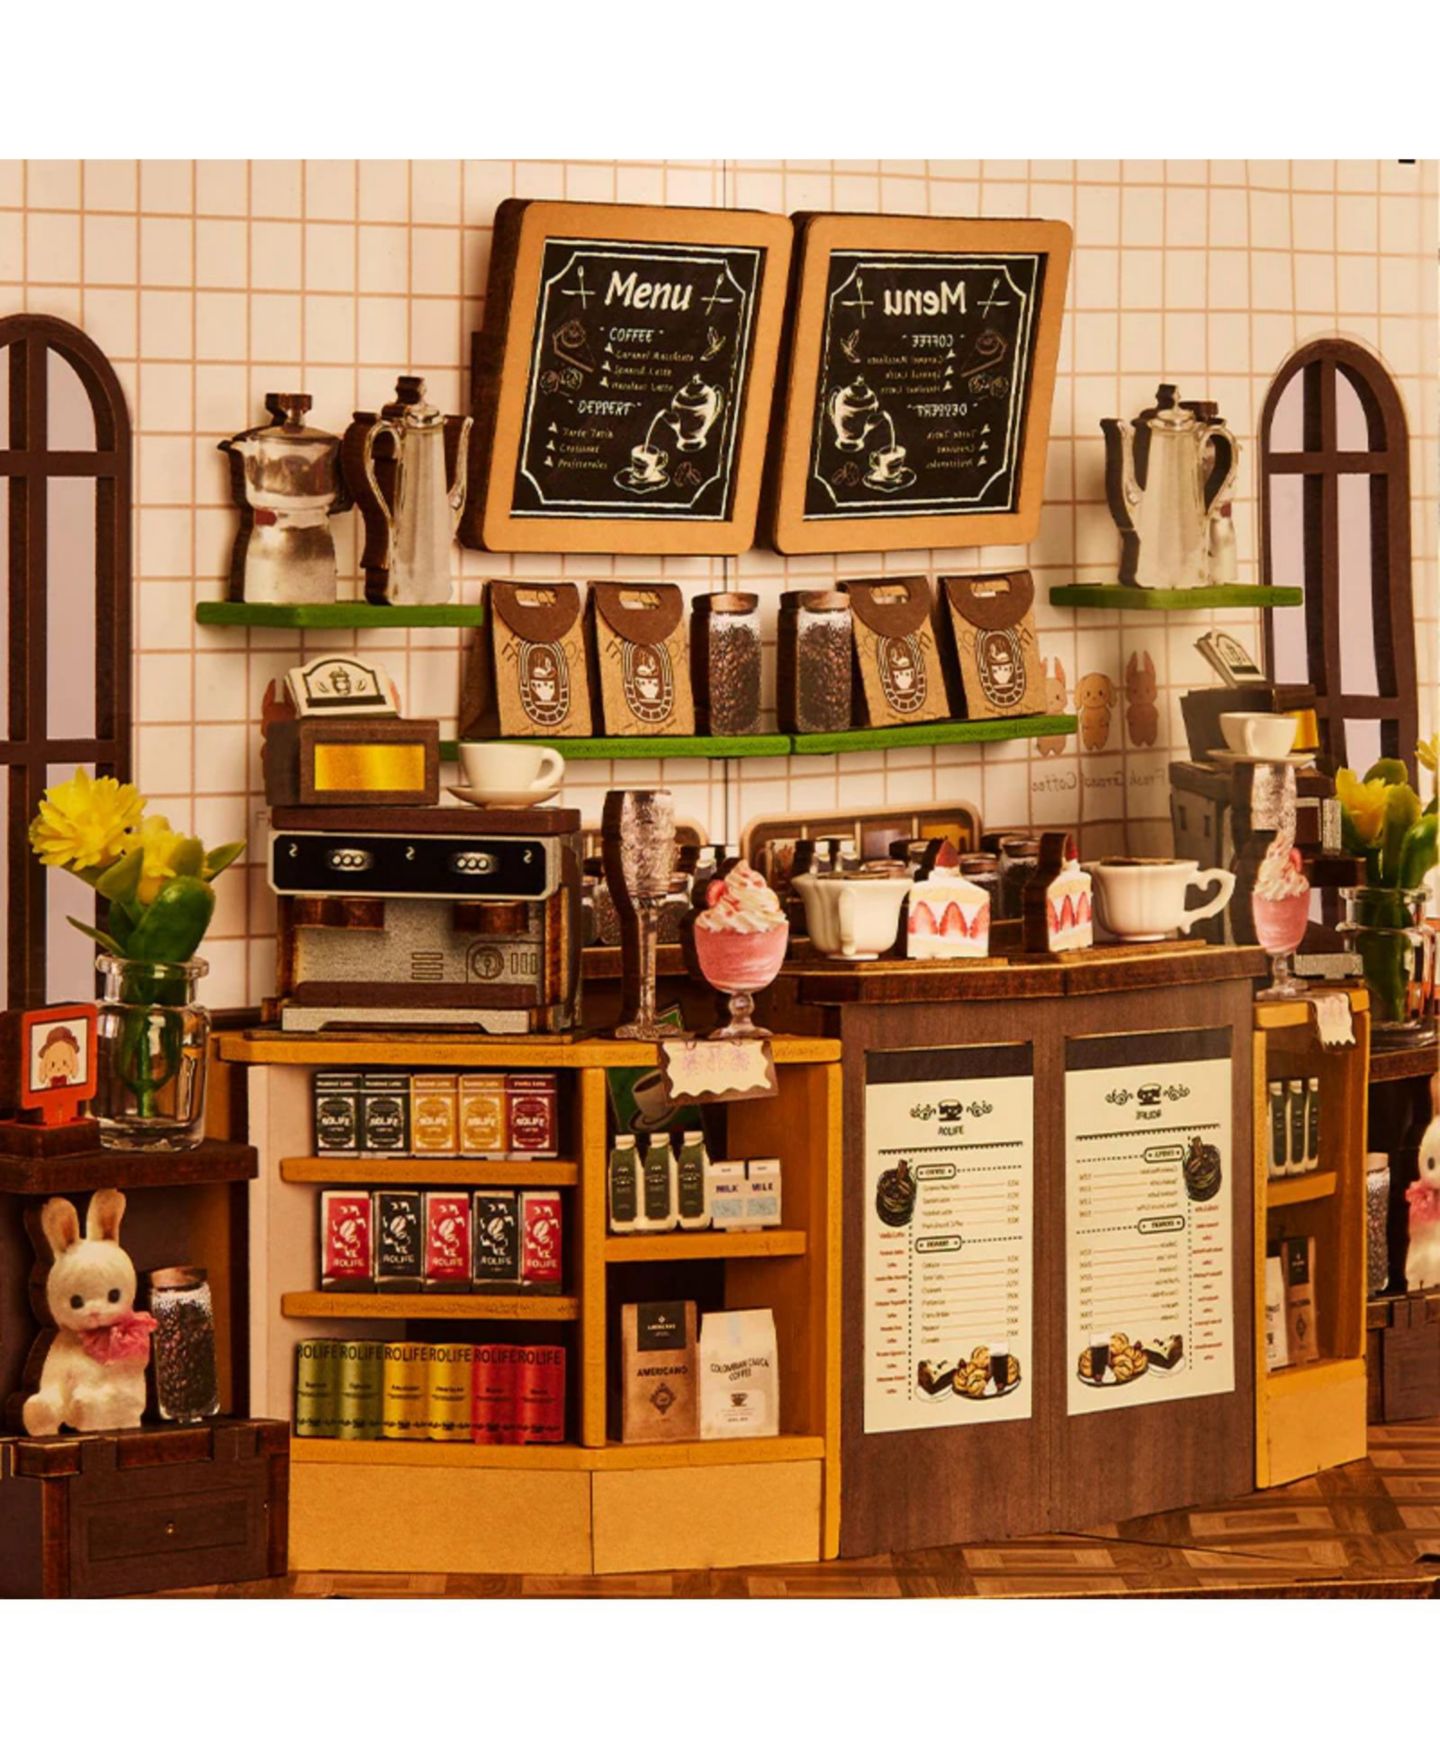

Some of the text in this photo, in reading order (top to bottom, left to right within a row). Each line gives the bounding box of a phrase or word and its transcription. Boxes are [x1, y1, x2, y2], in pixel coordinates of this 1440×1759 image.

[604, 270, 693, 312] Menu
[609, 326, 655, 343] COFFEE
[382, 1254, 415, 1264] ROLIFE
[385, 1346, 427, 1362] ROLIFE
[429, 1348, 472, 1363] ROLIFE
[474, 1349, 517, 1364] ROLIFE
[637, 1364, 689, 1377] AMERICANO
[728, 1367, 752, 1381] COFFEE
